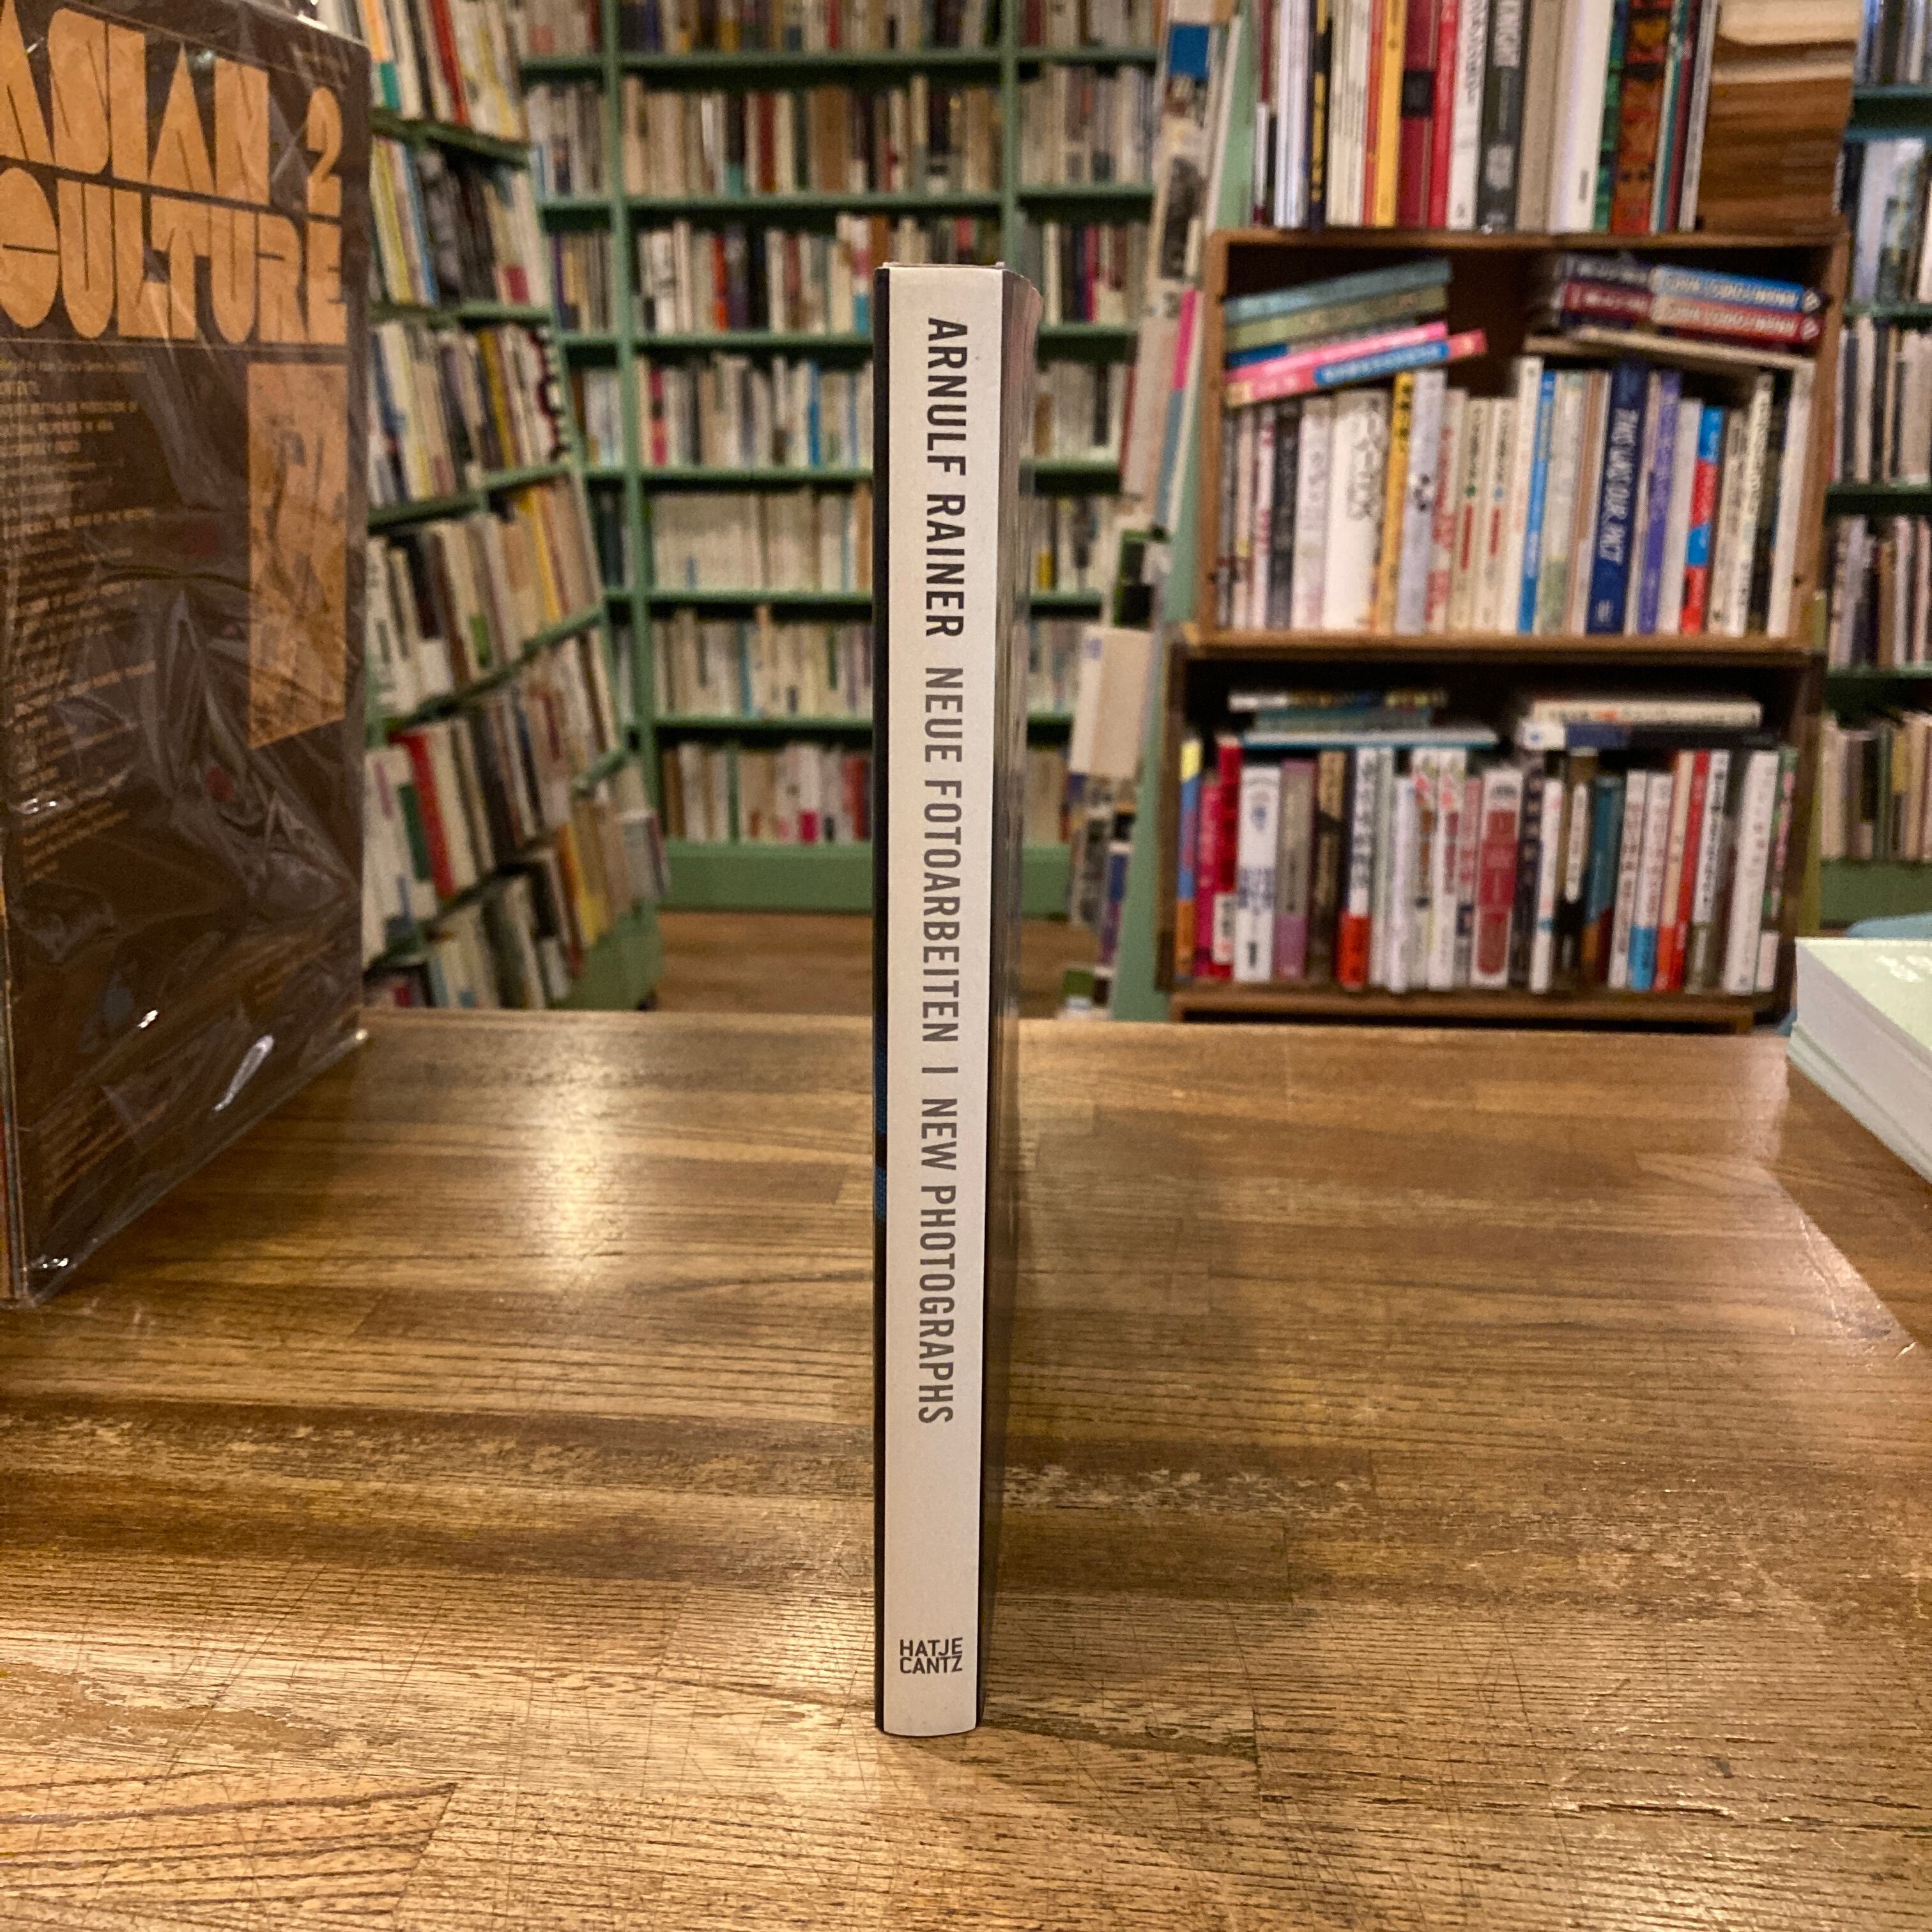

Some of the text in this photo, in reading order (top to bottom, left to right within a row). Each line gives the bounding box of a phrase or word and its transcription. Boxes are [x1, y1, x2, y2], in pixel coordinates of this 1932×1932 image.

[0, 167, 348, 344] CULTURE
[926, 317, 968, 476] ARNULF
[925, 494, 966, 637] RAINER
[924, 668, 963, 763] NEUE
[921, 779, 962, 1042] FOTOARBEITEN
[921, 1098, 958, 1170] NEW
[918, 1185, 956, 1423] PHOTOGRAPHS
[900, 1637, 963, 1657] HATJE
[900, 1655, 963, 1675] CANTZ
